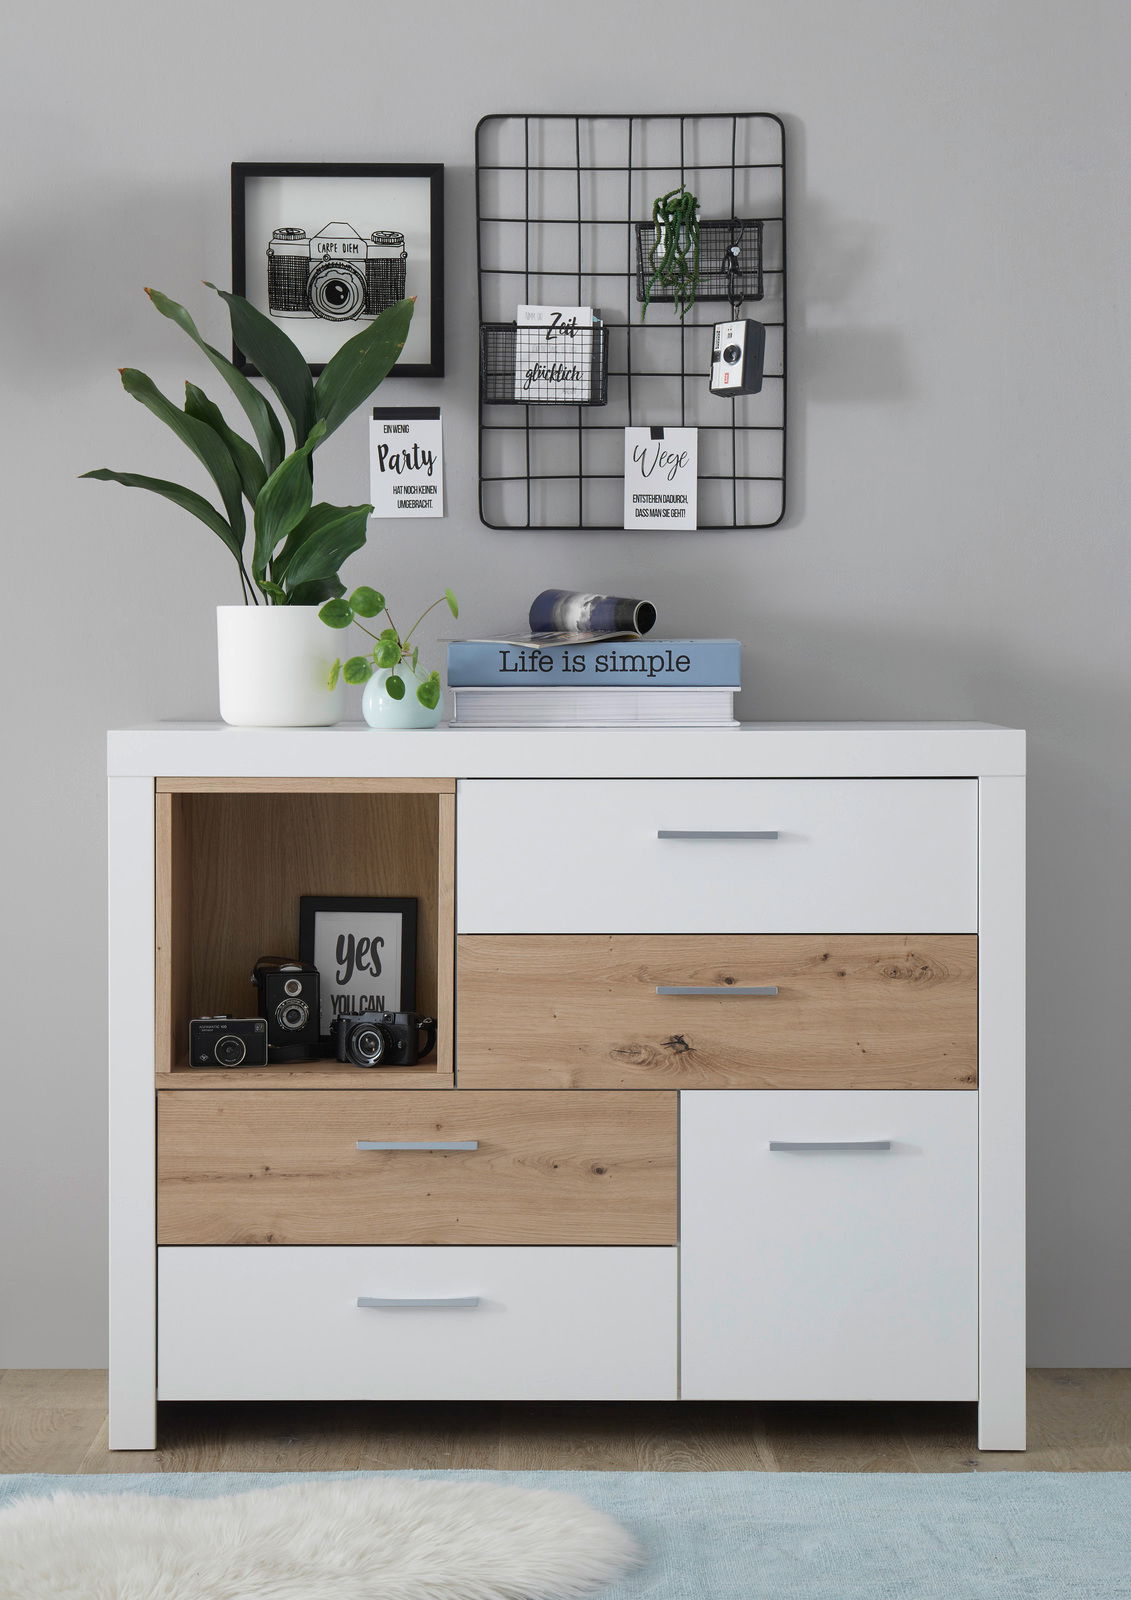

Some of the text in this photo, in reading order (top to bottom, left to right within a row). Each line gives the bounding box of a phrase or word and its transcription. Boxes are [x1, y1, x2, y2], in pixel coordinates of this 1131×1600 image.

[317, 242, 359, 254] CARPE DIEM
[546, 312, 578, 340] Zeit
[523, 363, 583, 390] glücklich
[383, 424, 410, 433] EIN WENIG
[377, 443, 438, 476] Party
[633, 442, 689, 481] Wege
[393, 485, 437, 494] HAT NOCH KEINEN
[397, 499, 433, 509] UMGEBRACHT.
[632, 494, 689, 504] ENTSTEHEN DADURCH,
[635, 508, 686, 518] DASS MAN SIE GEHT!
[498, 650, 691, 677] Life is simple
[336, 933, 384, 986] yes
[360, 995, 385, 1012] CAN
